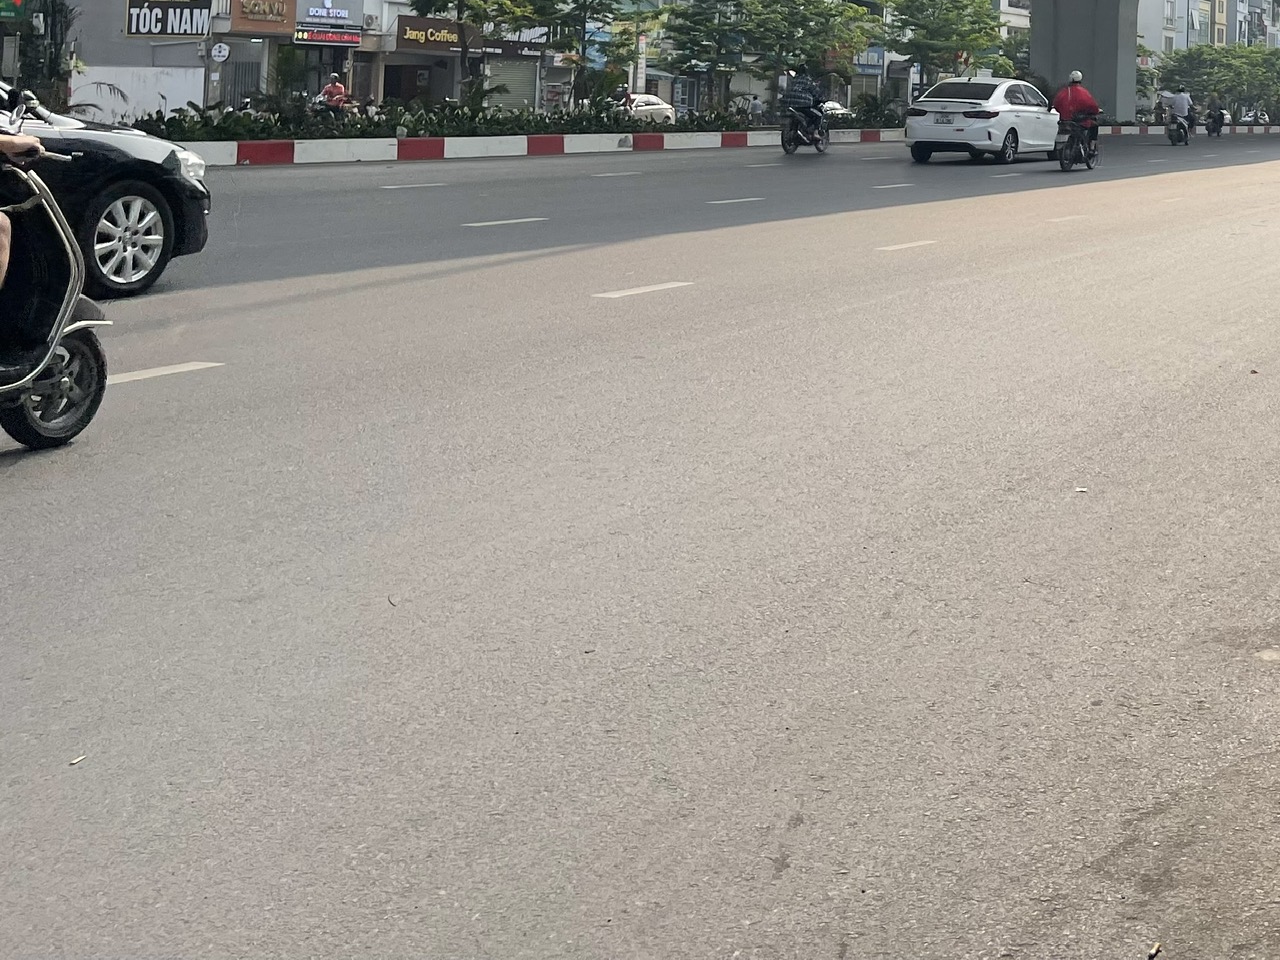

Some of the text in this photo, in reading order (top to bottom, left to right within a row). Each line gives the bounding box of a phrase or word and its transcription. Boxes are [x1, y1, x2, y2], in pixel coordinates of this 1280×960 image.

[130, 2, 209, 34] TÓC NAM
[309, 7, 349, 18] DONE STORE
[403, 26, 459, 43] Jang Coffee
